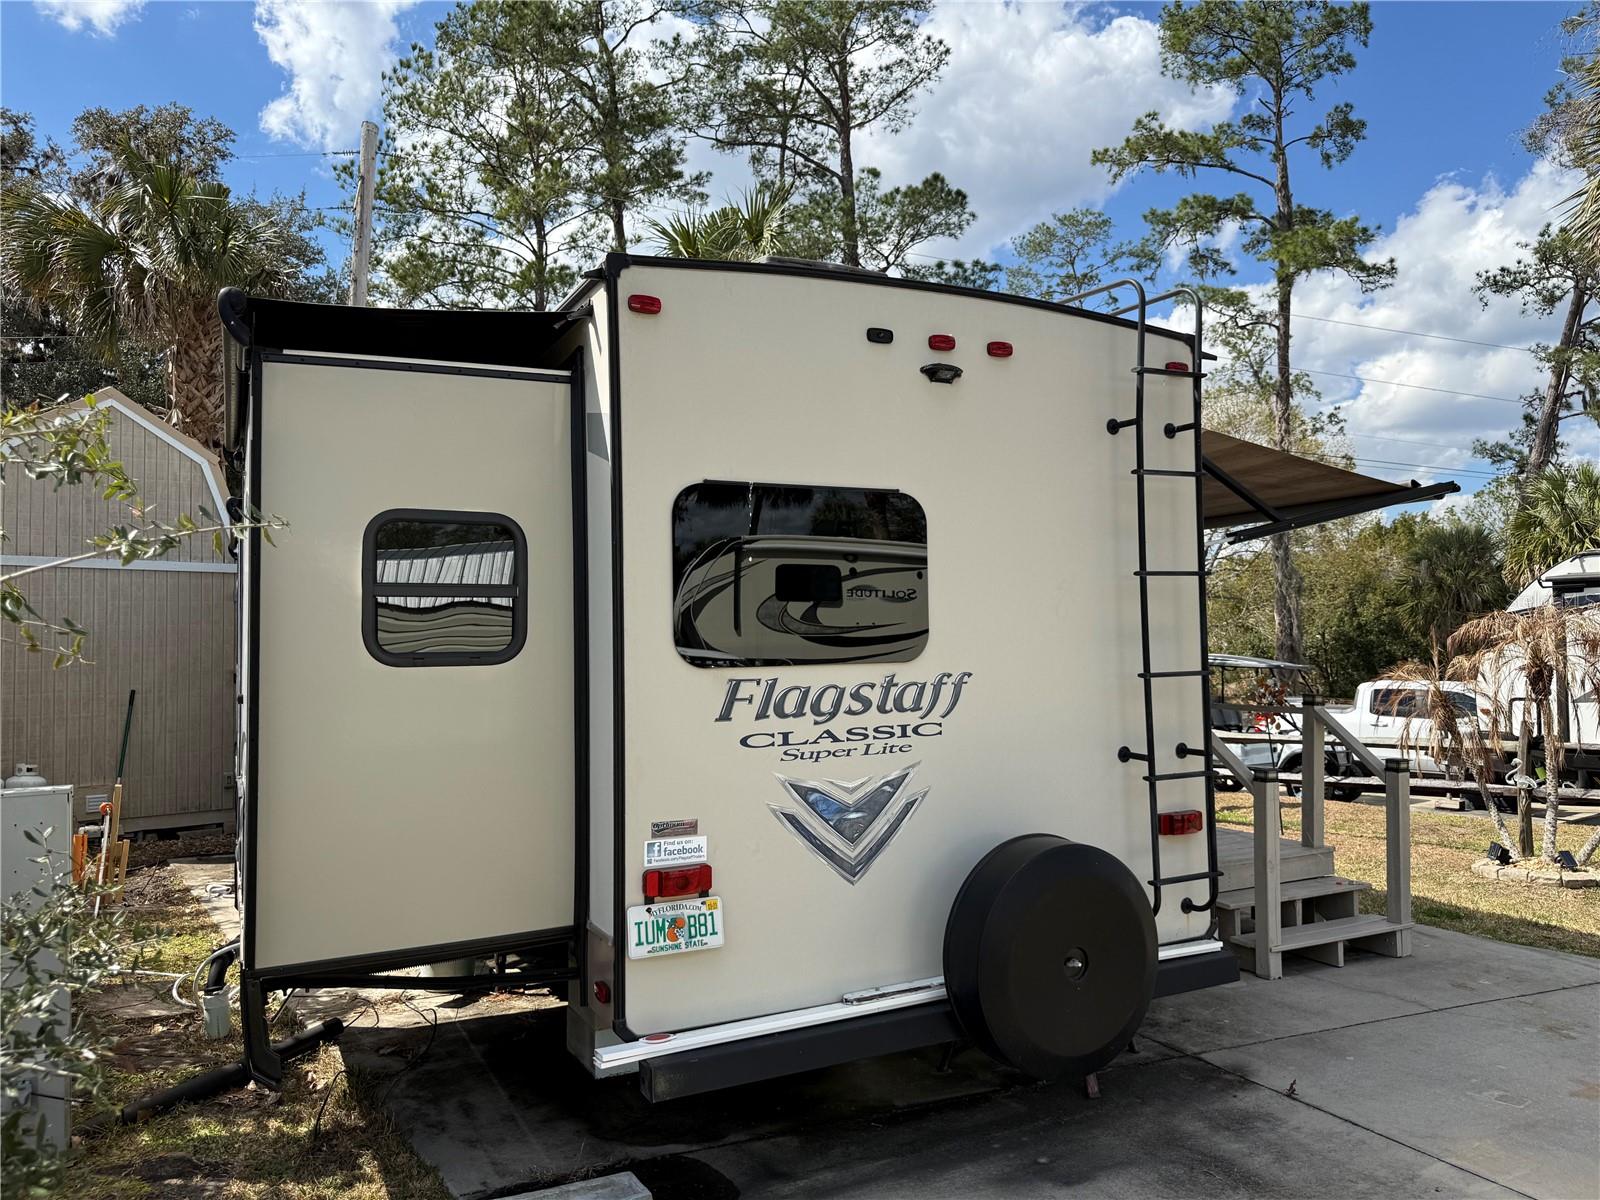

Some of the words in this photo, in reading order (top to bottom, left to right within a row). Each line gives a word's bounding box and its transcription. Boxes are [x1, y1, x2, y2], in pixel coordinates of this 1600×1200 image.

[714, 671, 973, 725] Flagstaff
[739, 722, 943, 748] CLASSIC
[780, 746, 857, 763] Super
[861, 742, 913, 756] Lite
[663, 844, 703, 857] facebook
[634, 918, 667, 947] IUM
[687, 912, 718, 940] B81
[651, 942, 682, 953] SUNSHINE
[685, 939, 705, 950] STATE
